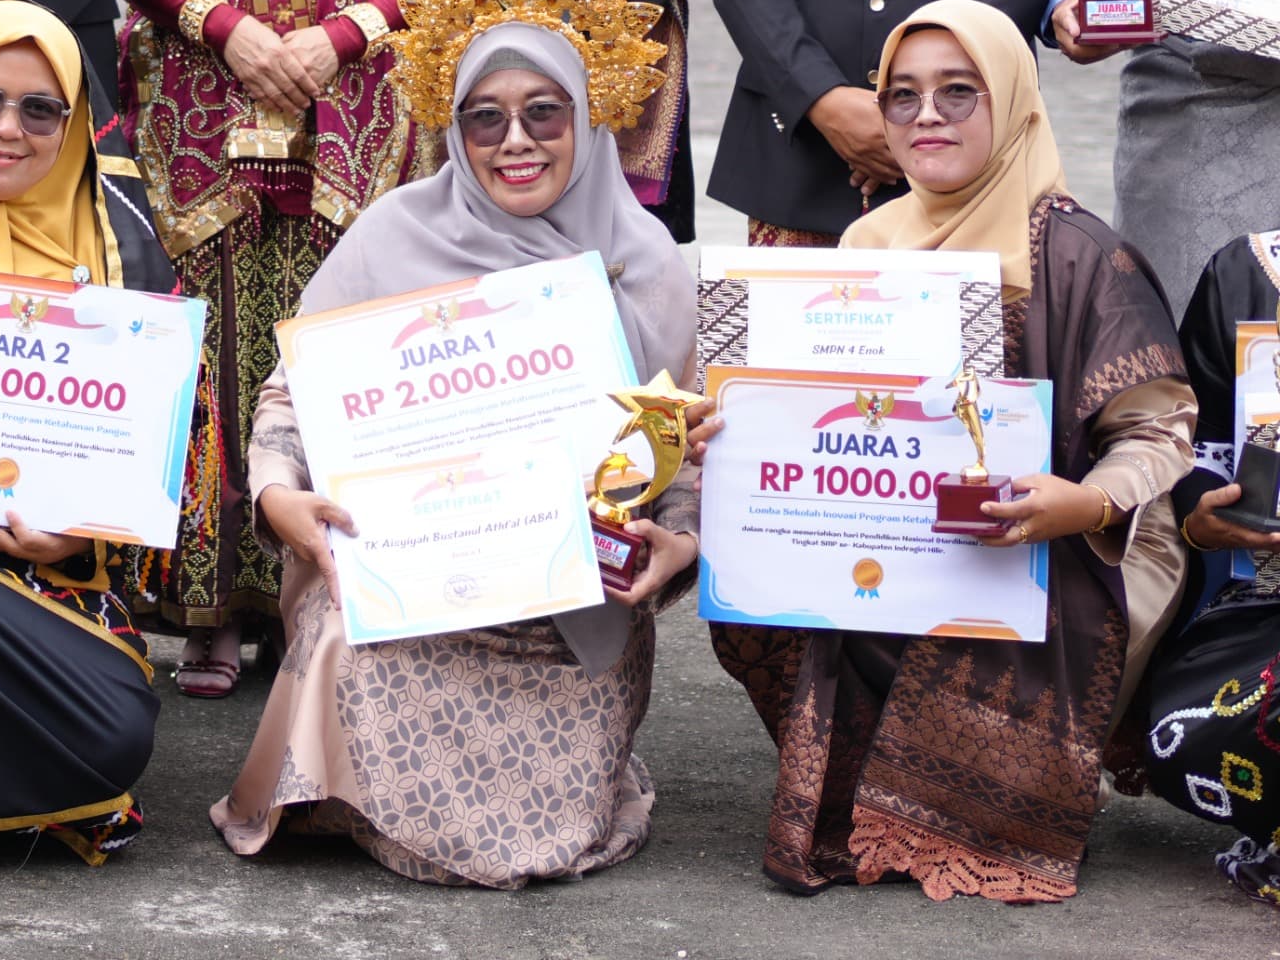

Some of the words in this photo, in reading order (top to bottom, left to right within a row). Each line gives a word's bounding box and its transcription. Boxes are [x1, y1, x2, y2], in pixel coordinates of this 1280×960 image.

[1098, 3, 1128, 13] JUARA
[804, 312, 894, 324] SERTIFIKAT
[53, 342, 70, 364] 2
[399, 335, 481, 370] JUARA
[483, 329, 496, 349] 1
[812, 344, 845, 355] SMPN
[848, 345, 855, 355] 4
[858, 345, 885, 355] Enok
[342, 388, 385, 421] RP
[395, 343, 574, 409] 2.000.000
[812, 432, 899, 458] JUARA
[905, 437, 921, 459] 3
[760, 462, 804, 492] RP
[414, 489, 501, 515] SERTIFIKAT
[749, 506, 779, 515] Lomba
[783, 508, 820, 517] Sekolah
[823, 510, 856, 519] Inovasi
[859, 512, 900, 524] Program
[363, 540, 378, 550] TK
[523, 509, 559, 525] (ABA)
